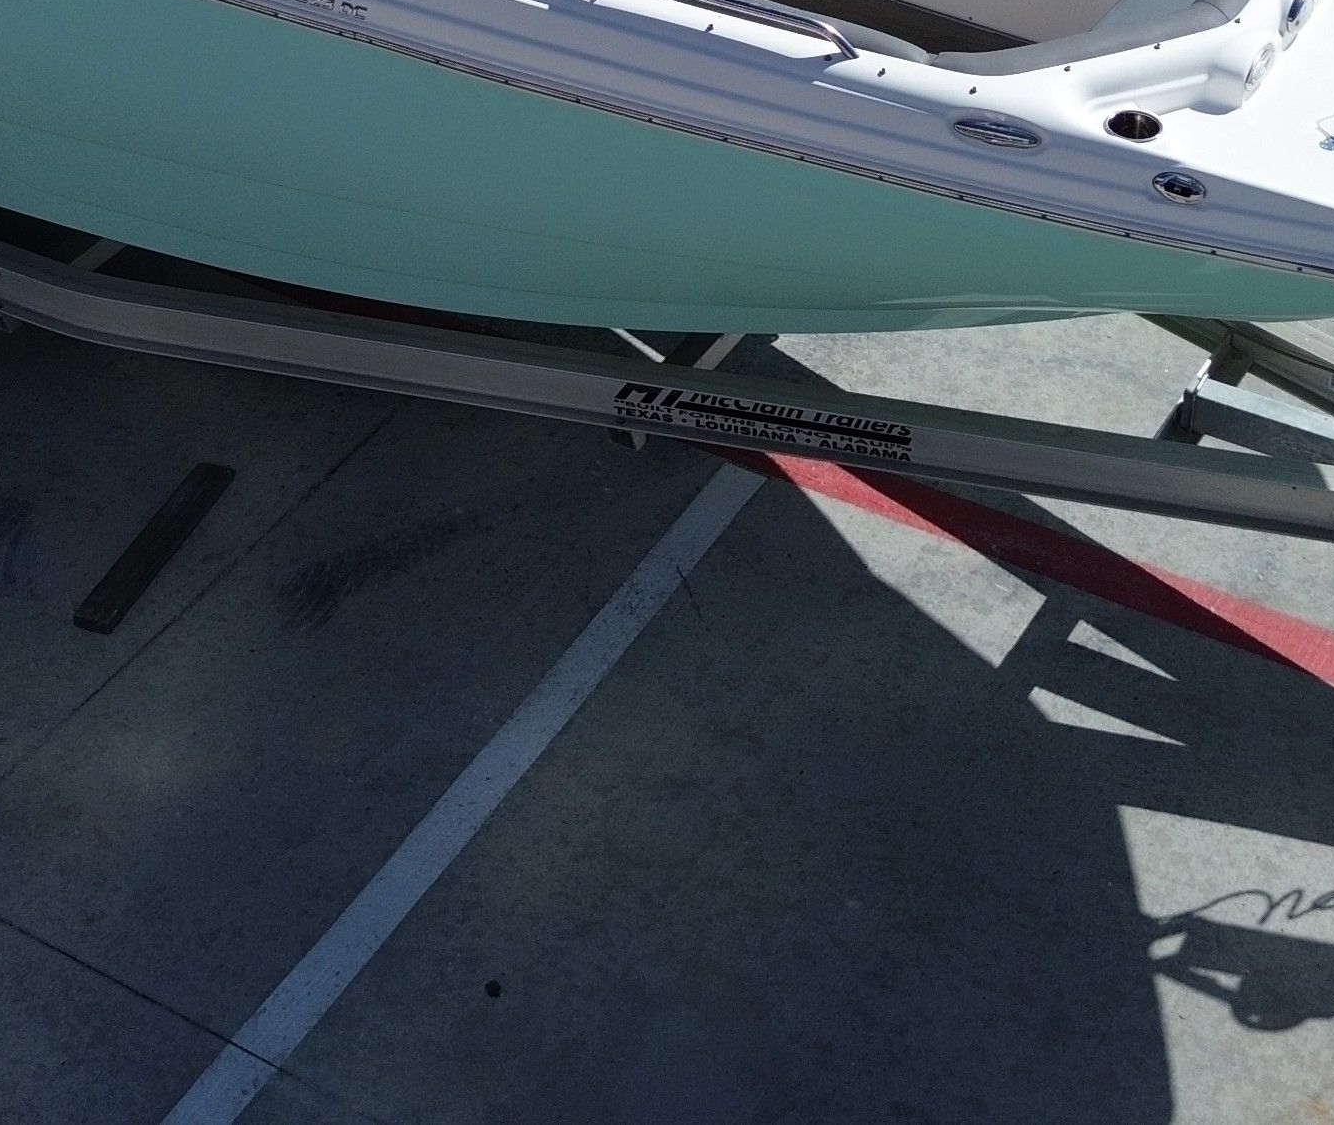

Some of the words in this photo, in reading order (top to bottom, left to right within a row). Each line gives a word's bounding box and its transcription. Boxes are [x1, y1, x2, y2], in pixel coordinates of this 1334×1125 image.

[339, 1, 368, 21] DC
[689, 392, 804, 420] McClain
[614, 405, 674, 423] TEXAS
[695, 418, 797, 444] LOUISIANA
[818, 439, 913, 462] ALABAMA
[678, 409, 719, 421] FOR
[720, 416, 756, 426] THE
[763, 423, 832, 440] LONG
